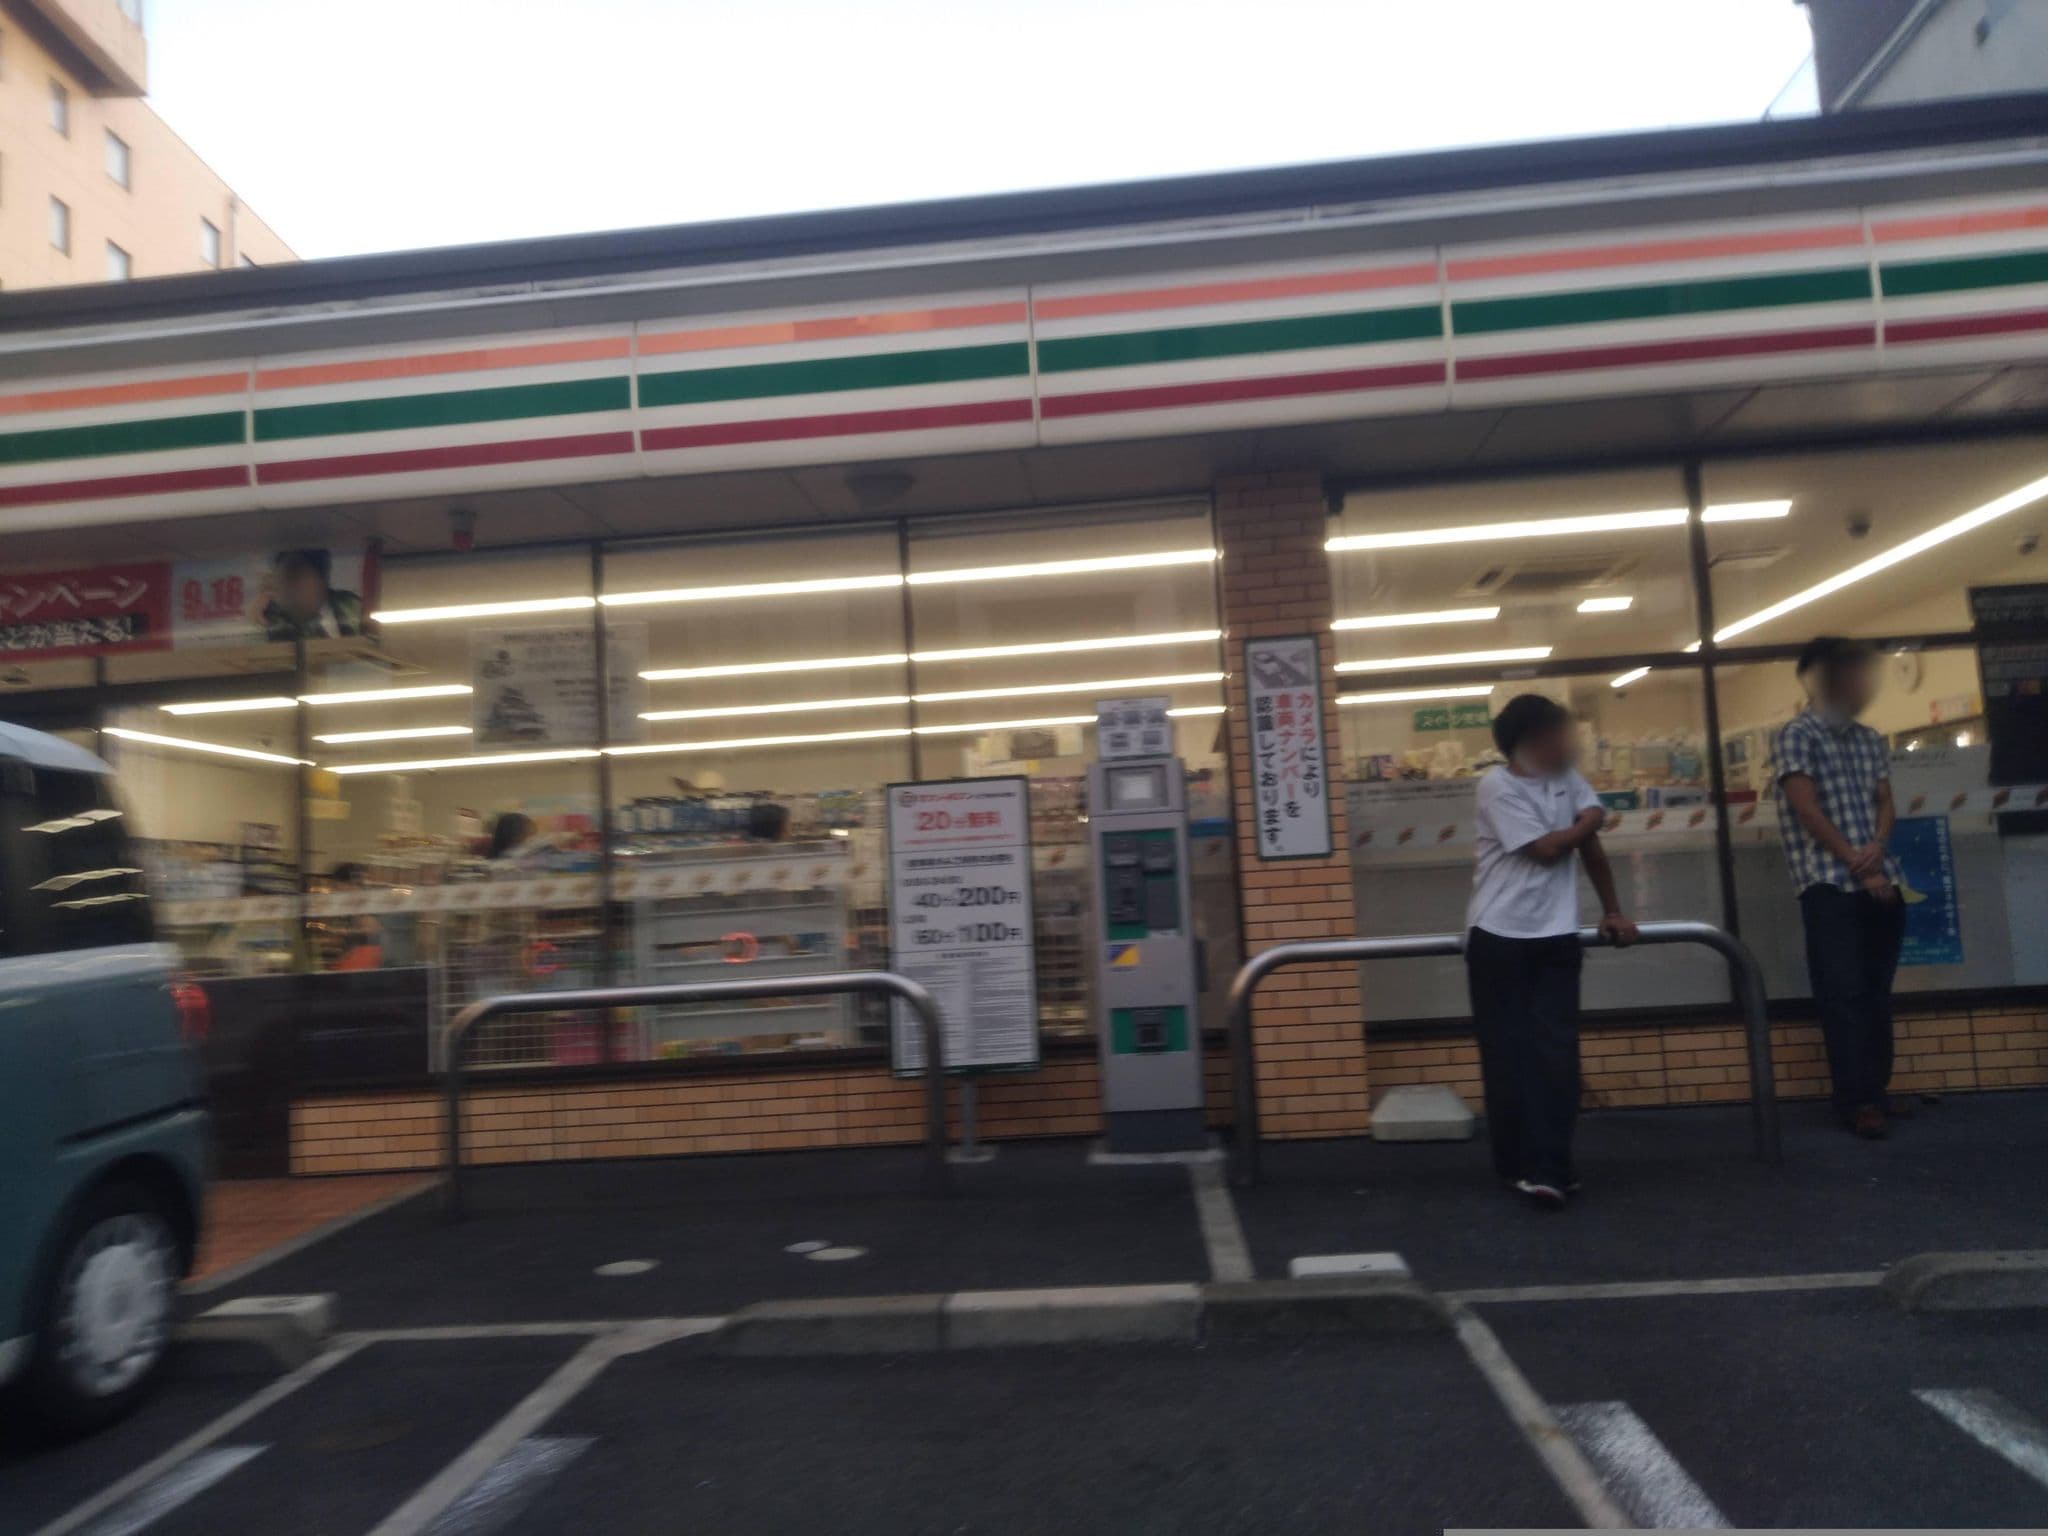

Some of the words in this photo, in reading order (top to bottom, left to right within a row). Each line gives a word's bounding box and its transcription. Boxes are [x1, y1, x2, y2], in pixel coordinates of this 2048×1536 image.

[1297, 693, 1321, 799] カメラにより
